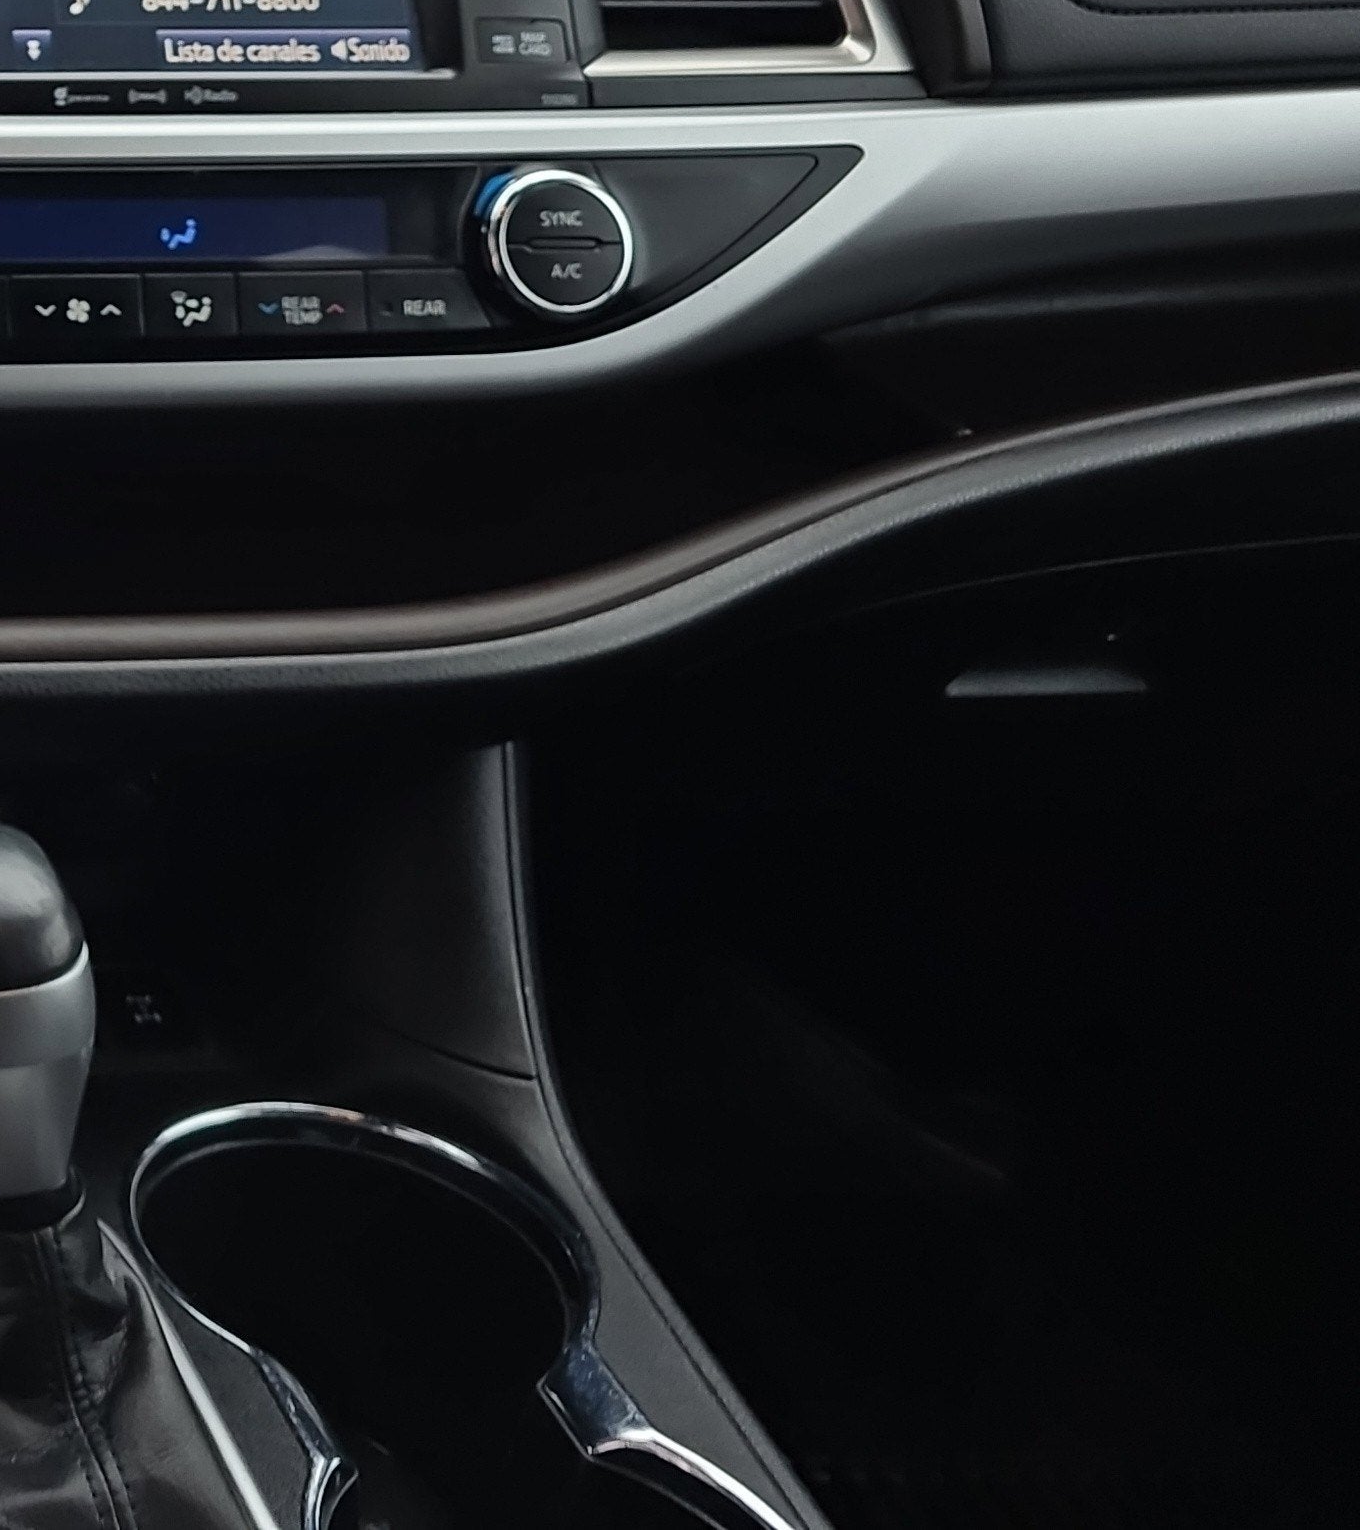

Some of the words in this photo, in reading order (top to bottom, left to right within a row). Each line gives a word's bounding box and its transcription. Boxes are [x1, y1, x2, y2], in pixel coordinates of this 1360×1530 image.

[165, 38, 215, 63] Lista
[217, 38, 245, 63] de
[246, 38, 321, 63] canales
[348, 37, 411, 63] Sonido
[539, 210, 583, 227] SYNC
[550, 263, 583, 280] A/C
[402, 299, 447, 317] REAR
